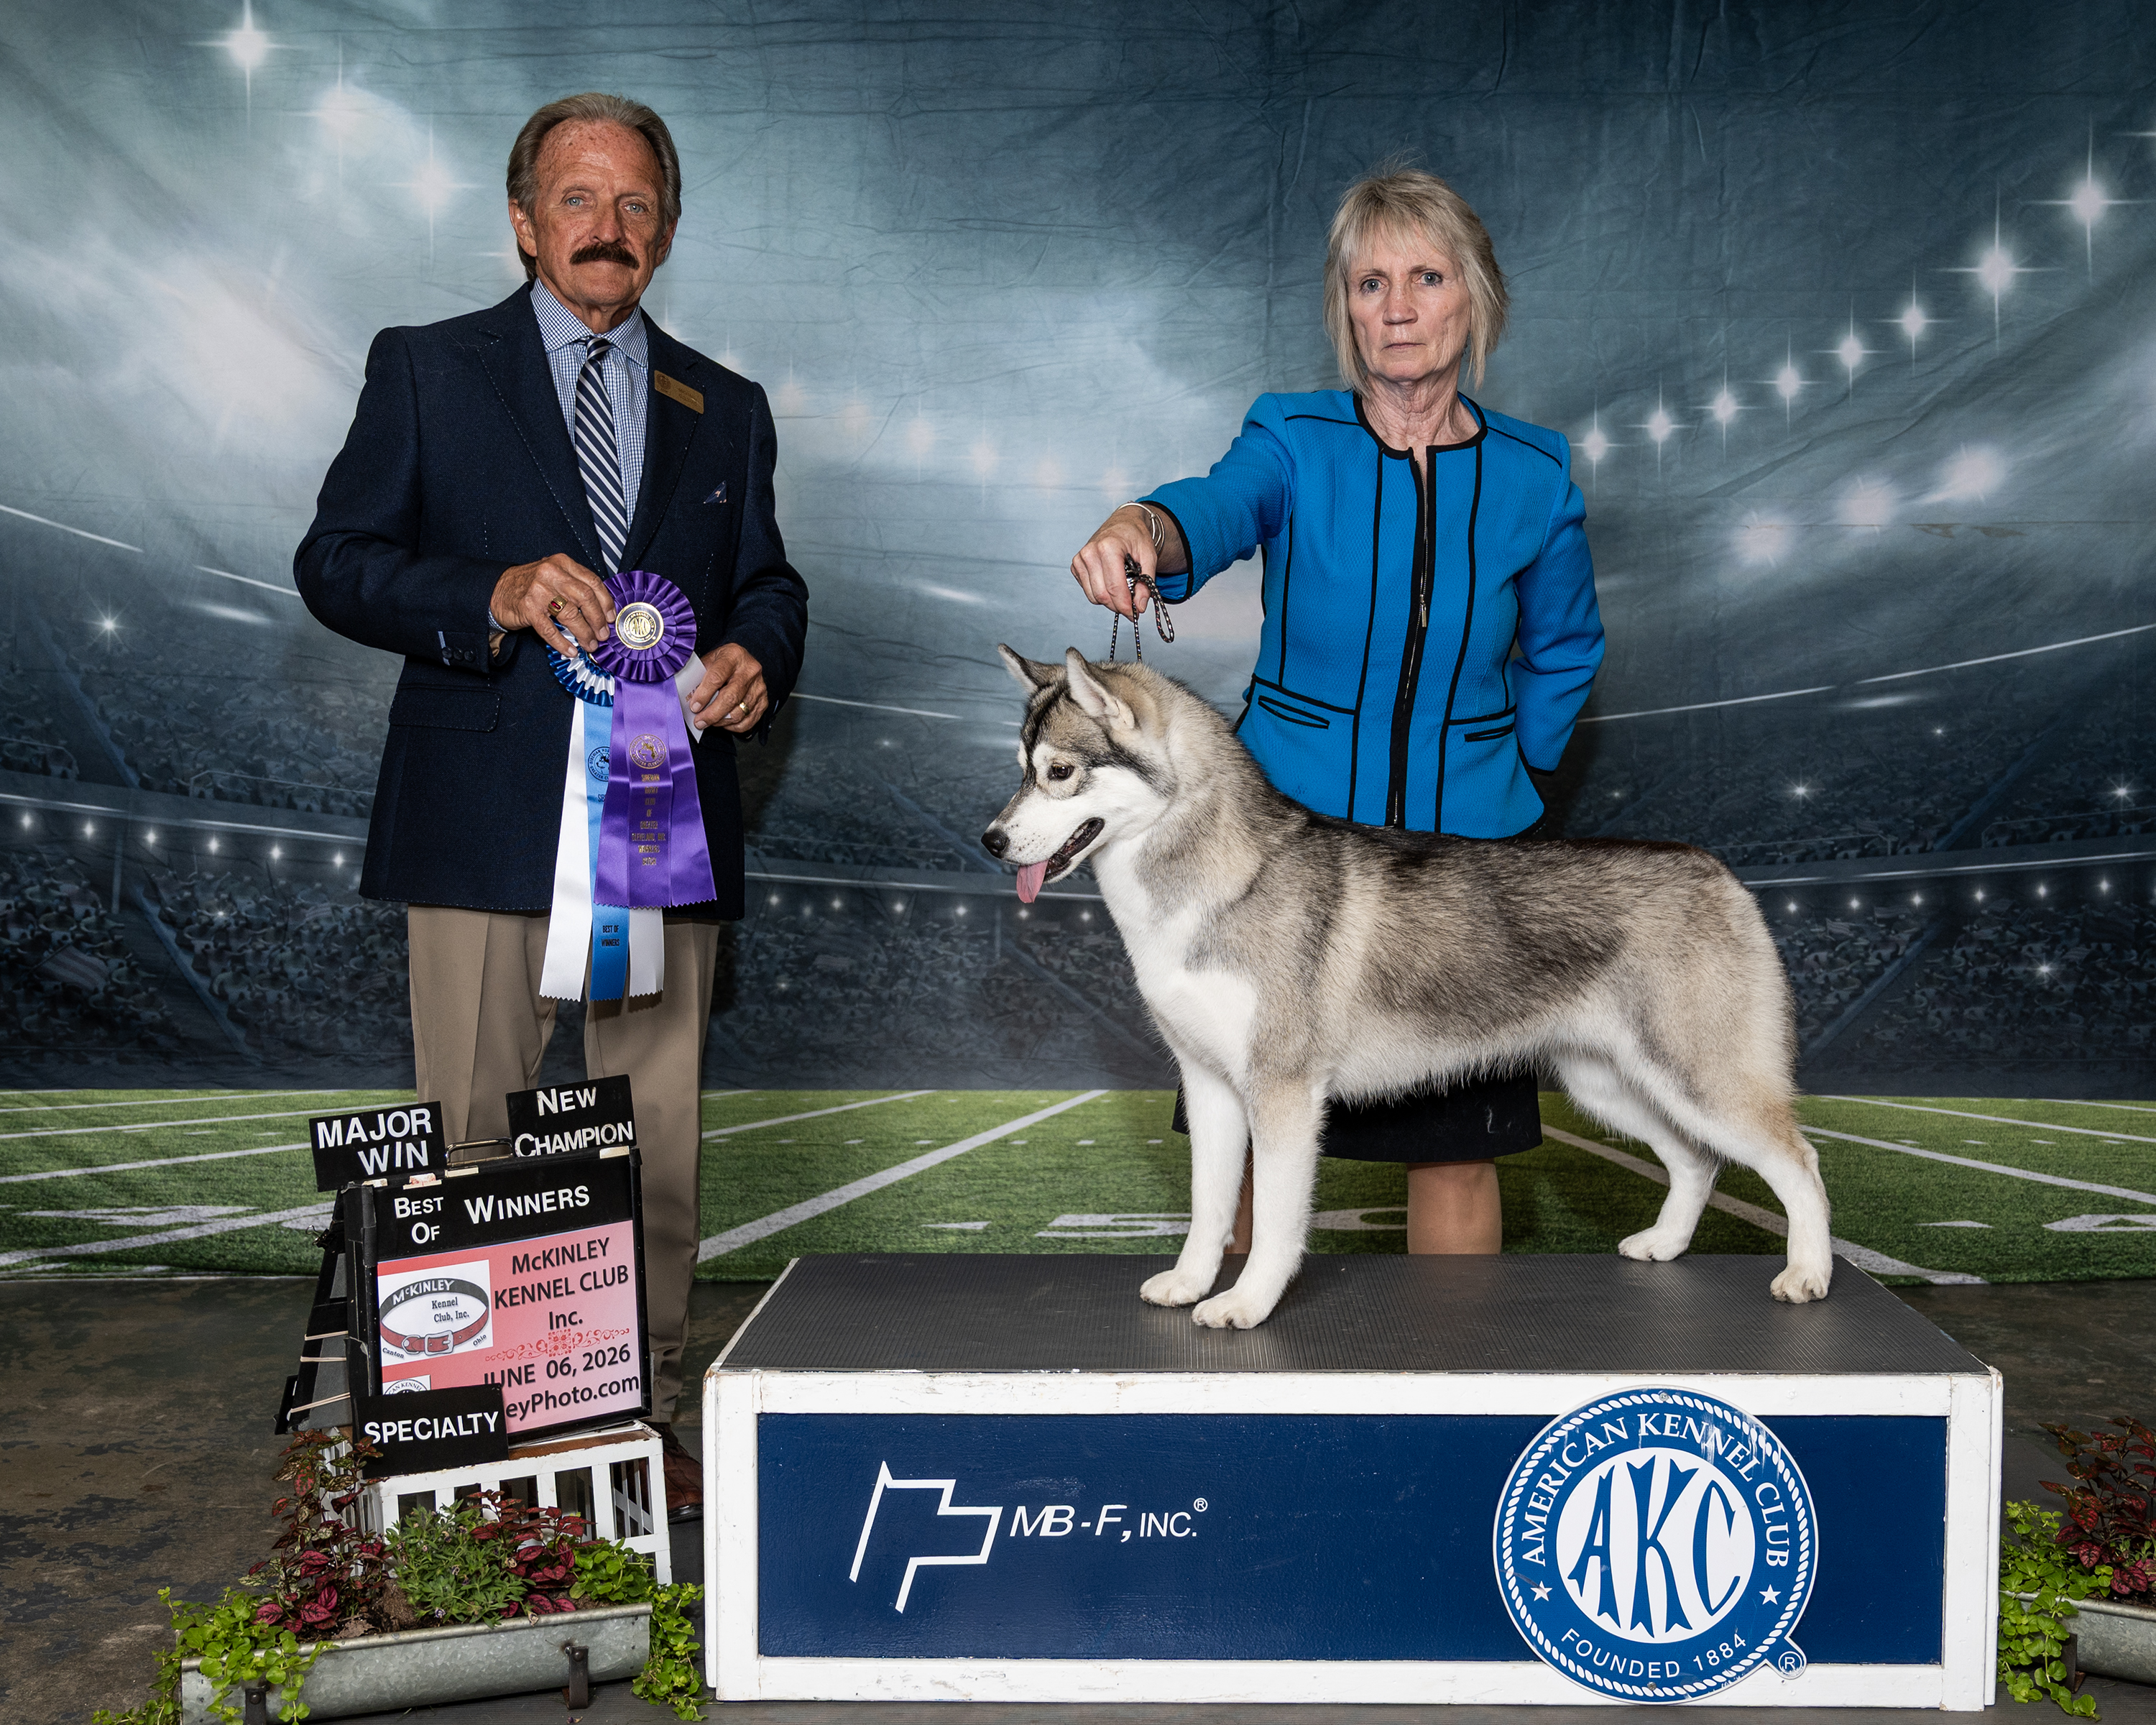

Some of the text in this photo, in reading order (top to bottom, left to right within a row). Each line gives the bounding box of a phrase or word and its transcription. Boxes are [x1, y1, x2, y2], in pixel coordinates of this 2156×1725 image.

[536, 1087, 596, 1116] NEW
[317, 1108, 432, 1149] MAJOR
[515, 1121, 633, 1158] CHAMPION
[358, 1140, 429, 1175] WIN
[394, 1197, 443, 1218] BEST
[464, 1185, 590, 1224] WINNERS
[412, 1223, 440, 1244] OF
[512, 1237, 609, 1274] McKINLEY
[392, 1279, 455, 1305] McKINLEY
[432, 1297, 458, 1310] Kennel
[494, 1265, 629, 1309] KENNEL CLUB
[433, 1310, 469, 1322] Club, Inc.
[548, 1310, 583, 1330] Inc.
[382, 1347, 405, 1358] Canton
[473, 1334, 487, 1346] Ohio
[545, 1356, 577, 1379] 06,
[582, 1343, 631, 1372] 2026
[505, 1375, 640, 1422] eyPhoto.com
[364, 1411, 499, 1444] SPECIALTY
[1522, 1412, 1790, 1568] AMERICAN KENNEL CLUB
[1567, 1454, 1741, 1639] AKC
[1560, 1627, 1747, 1678] FOUNDED 1884
